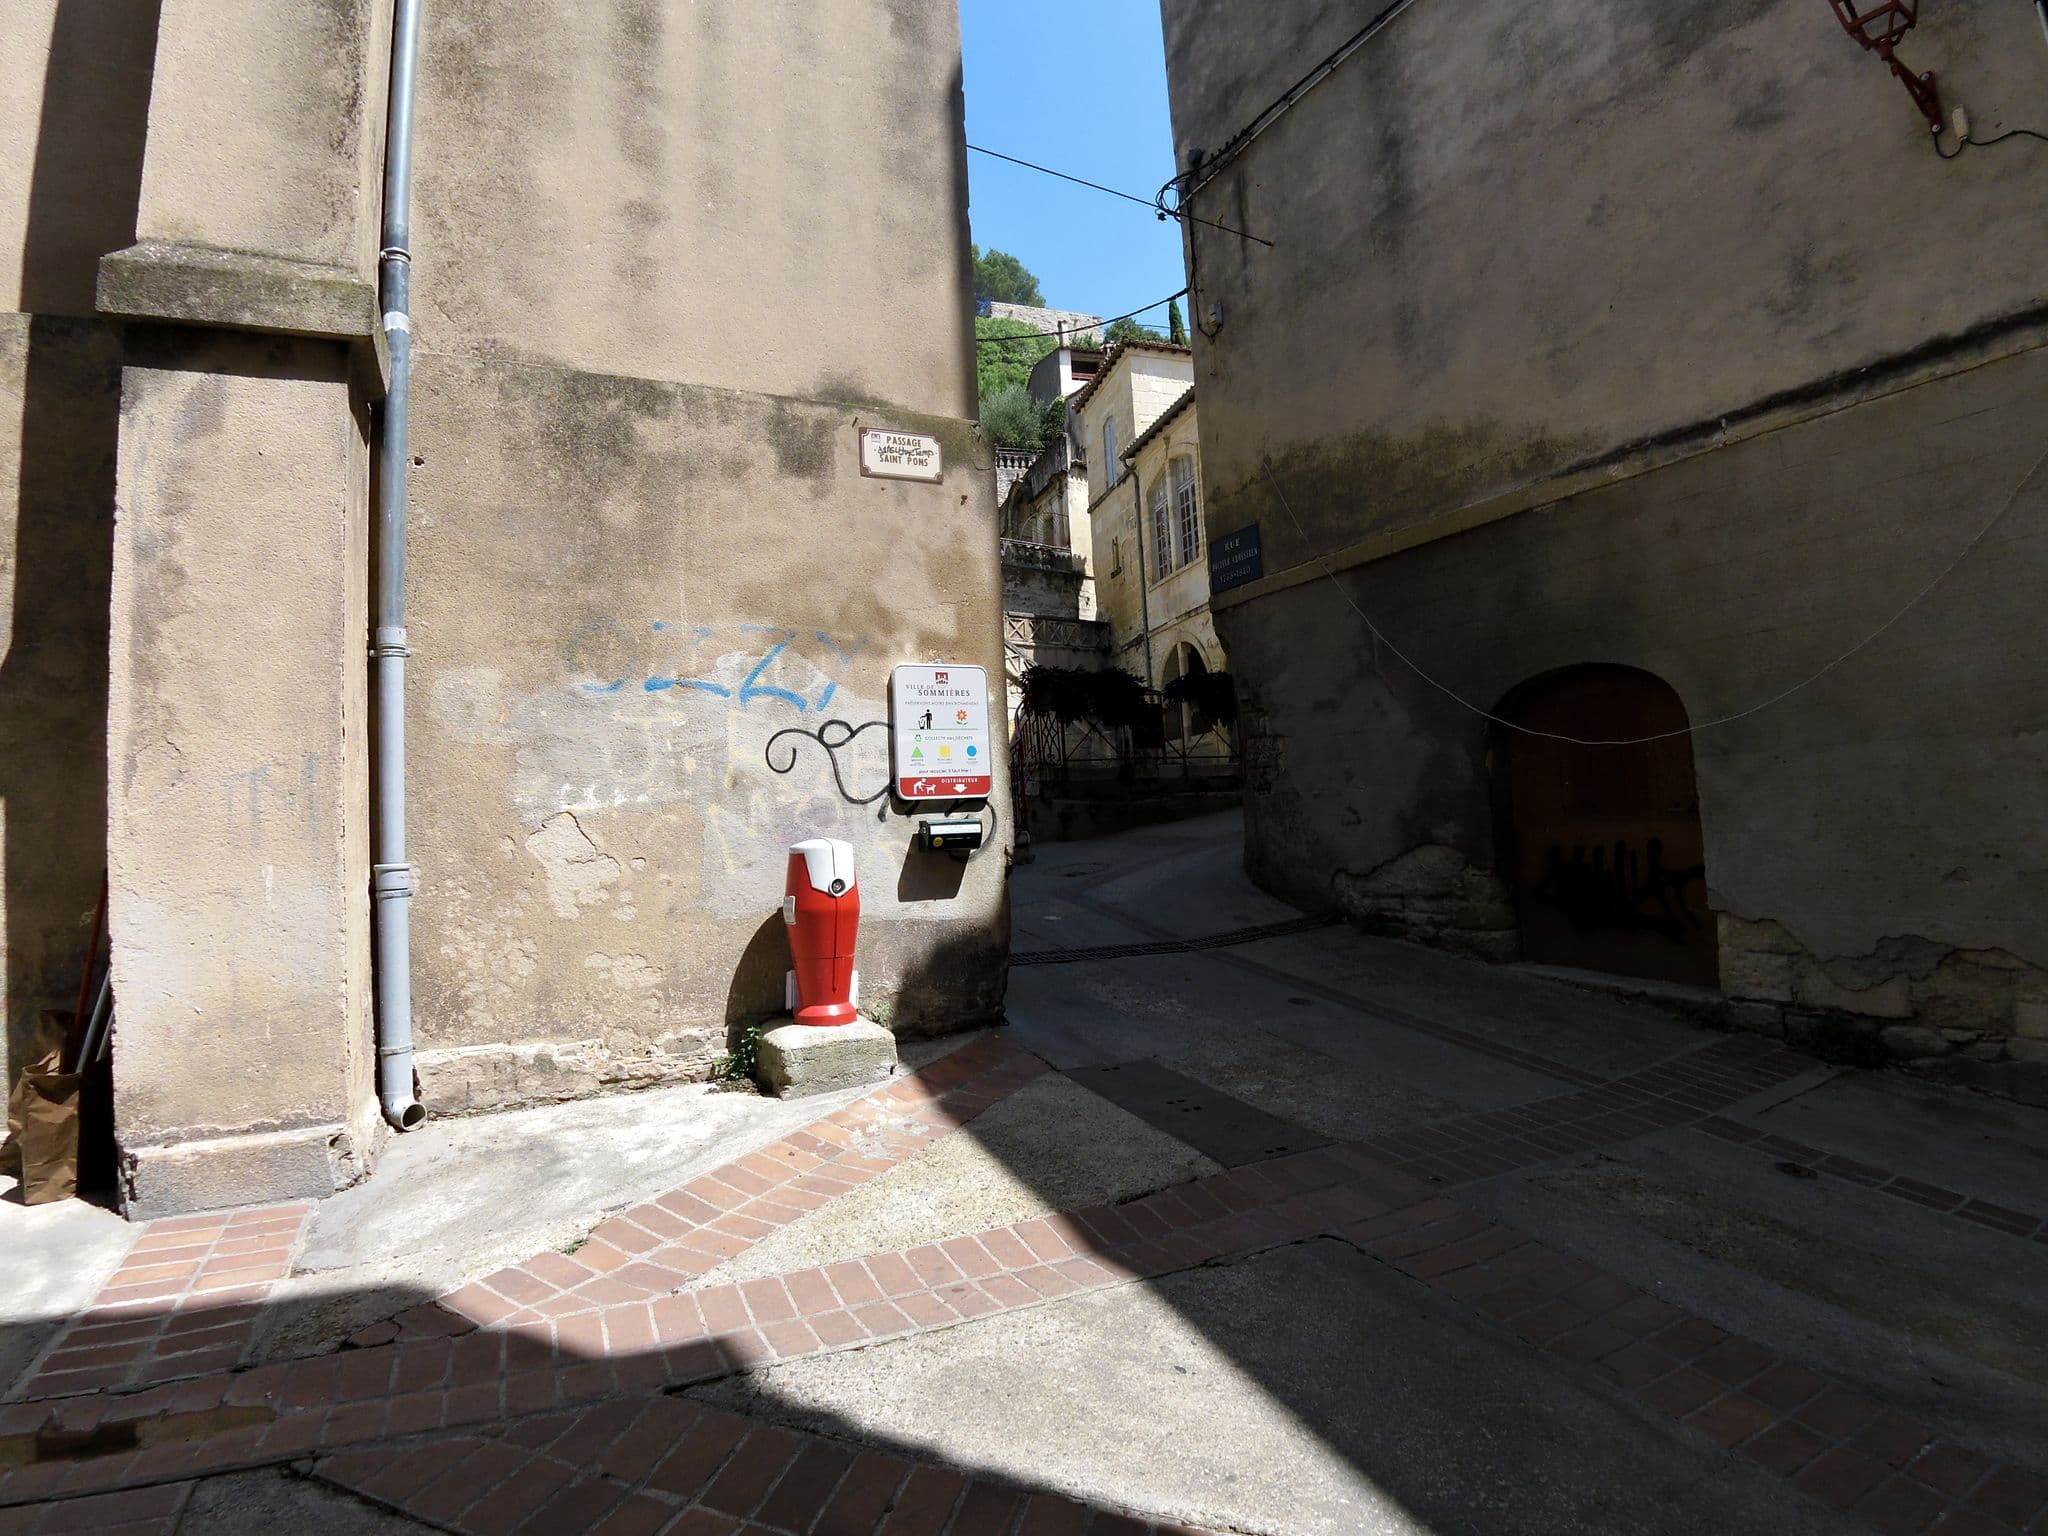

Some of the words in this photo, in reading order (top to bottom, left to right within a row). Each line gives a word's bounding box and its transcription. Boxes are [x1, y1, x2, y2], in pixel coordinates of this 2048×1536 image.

[887, 436, 921, 447] PASSAGE
[880, 454, 902, 464] SAINT
[907, 457, 929, 467] PONS
[918, 689, 970, 697] SOMMIÈRES
